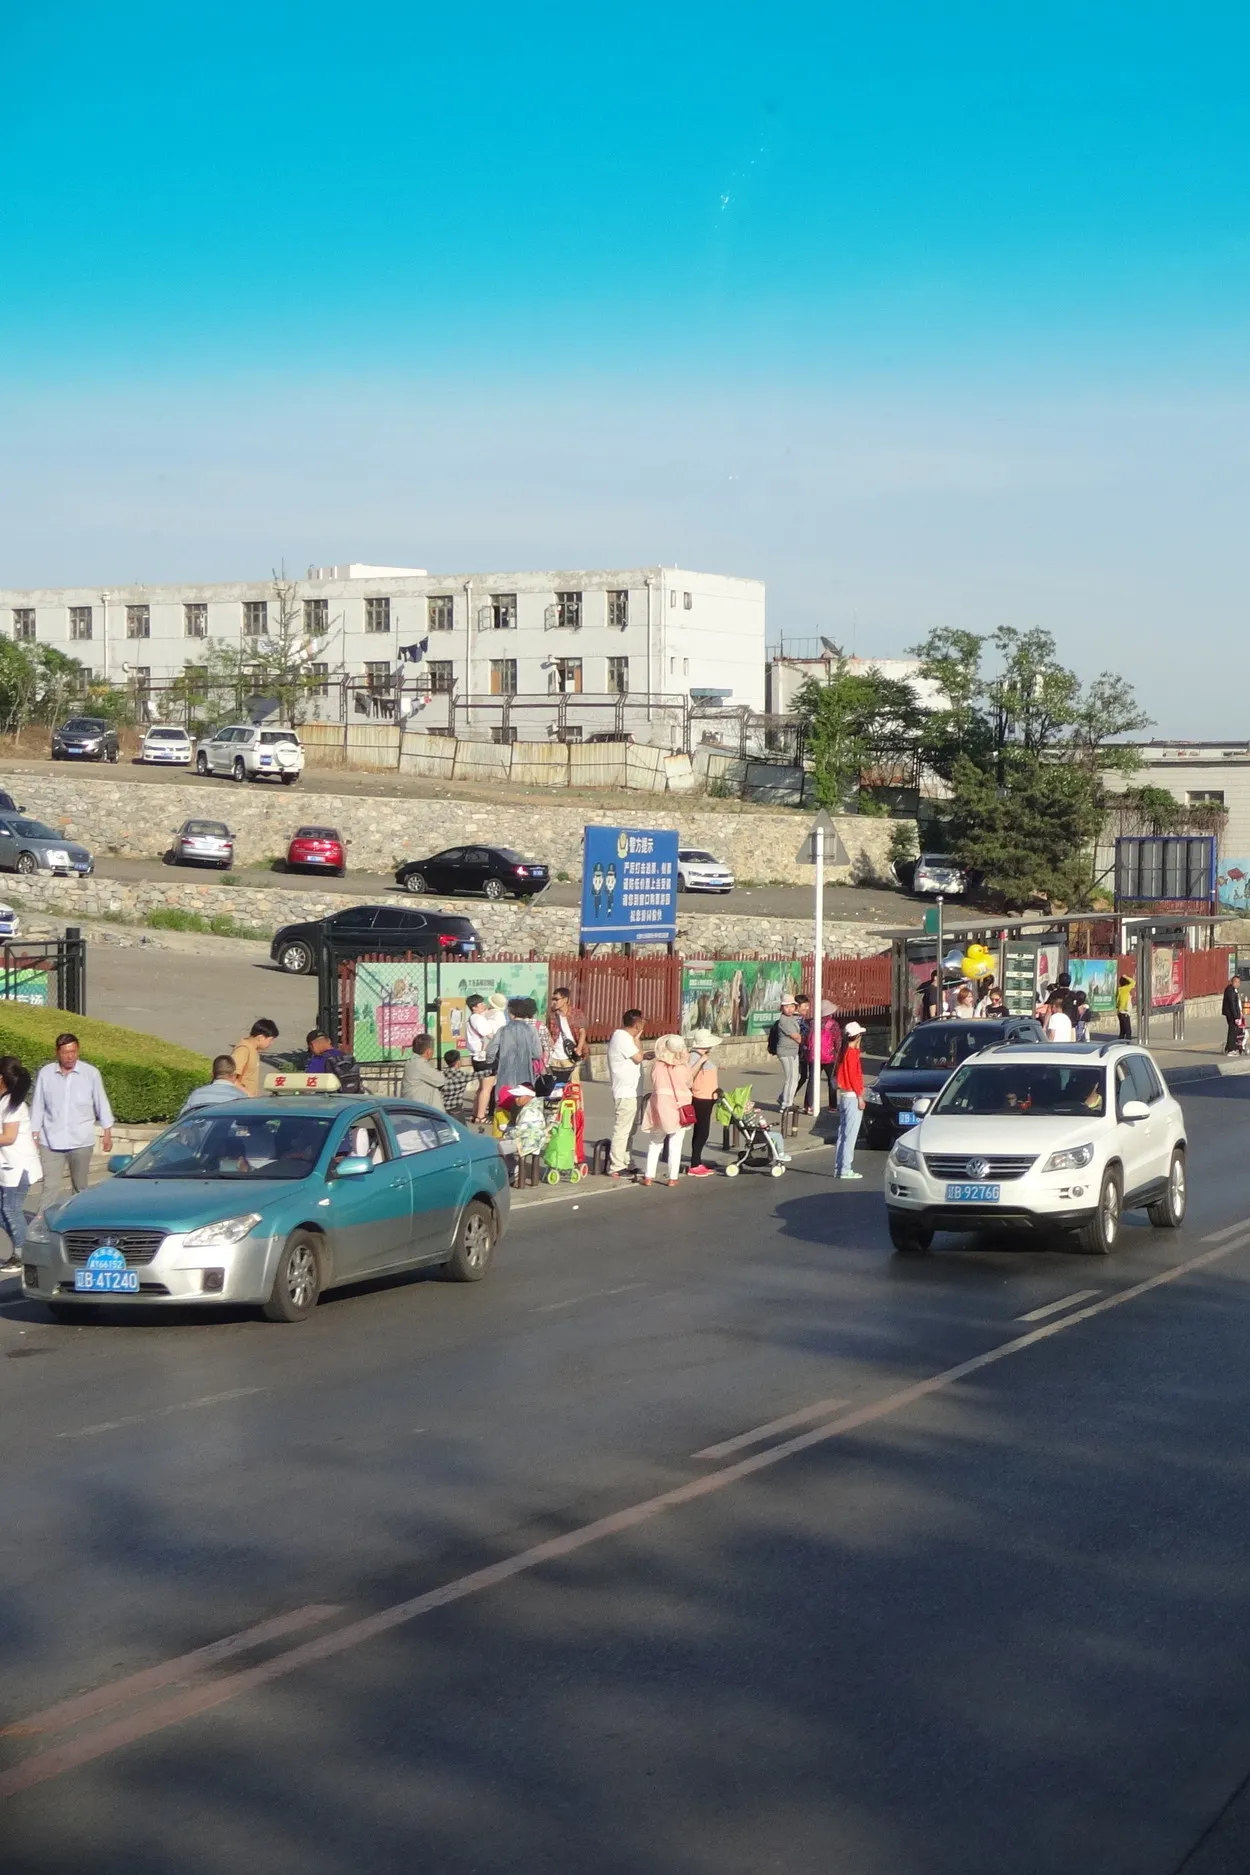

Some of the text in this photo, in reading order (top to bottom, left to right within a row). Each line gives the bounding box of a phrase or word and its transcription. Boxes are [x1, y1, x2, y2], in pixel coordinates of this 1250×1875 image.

[629, 836, 654, 853] 警方提示
[275, 1076, 318, 1087] 安达
